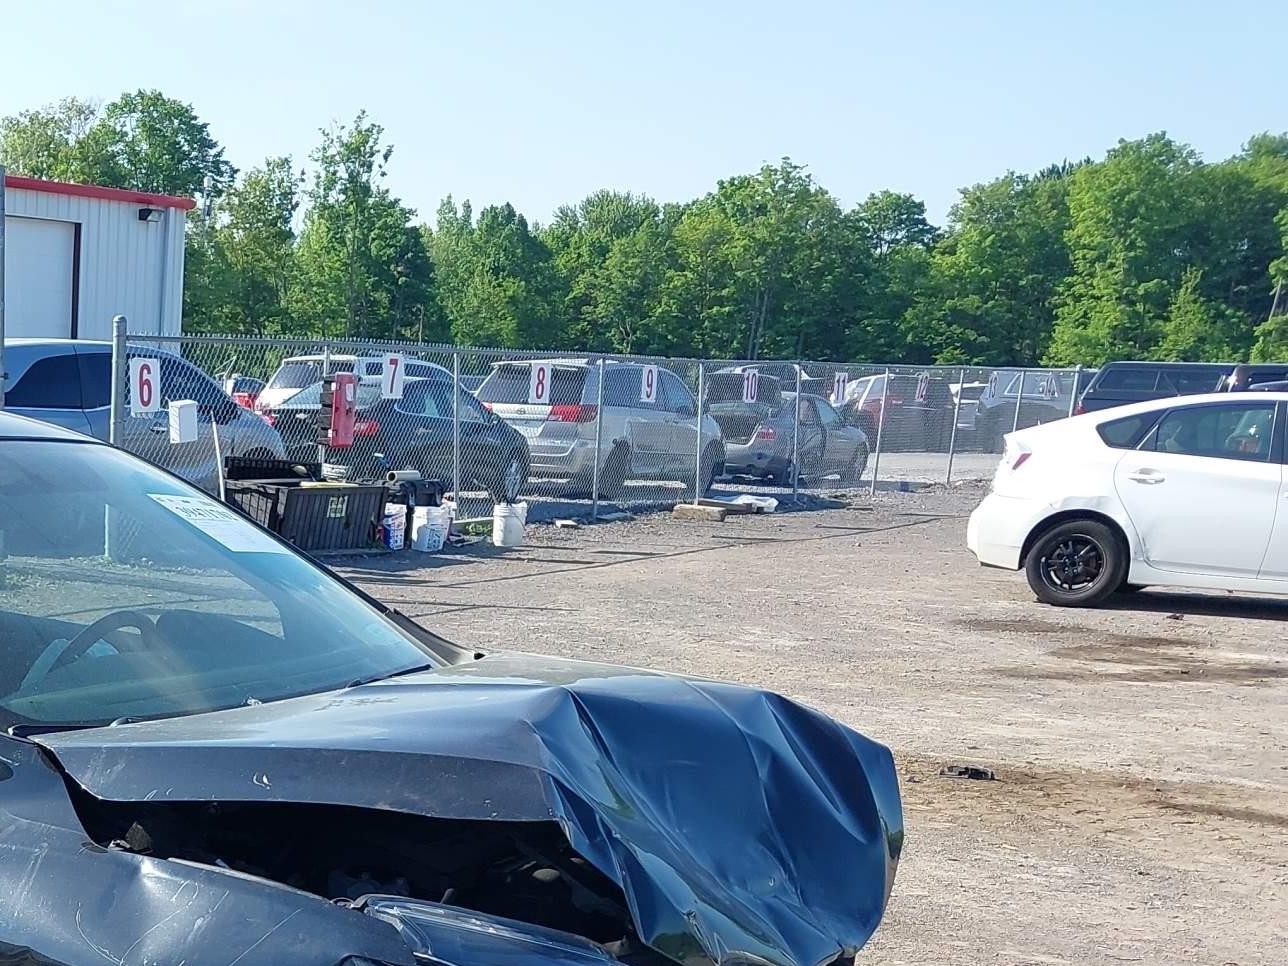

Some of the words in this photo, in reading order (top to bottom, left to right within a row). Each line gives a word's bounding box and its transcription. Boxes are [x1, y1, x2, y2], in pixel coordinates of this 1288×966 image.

[138, 363, 152, 408] 6
[389, 358, 399, 394] 7
[535, 366, 546, 400] 8
[646, 368, 654, 399] 9
[745, 371, 757, 401] 10
[836, 375, 846, 401] 11
